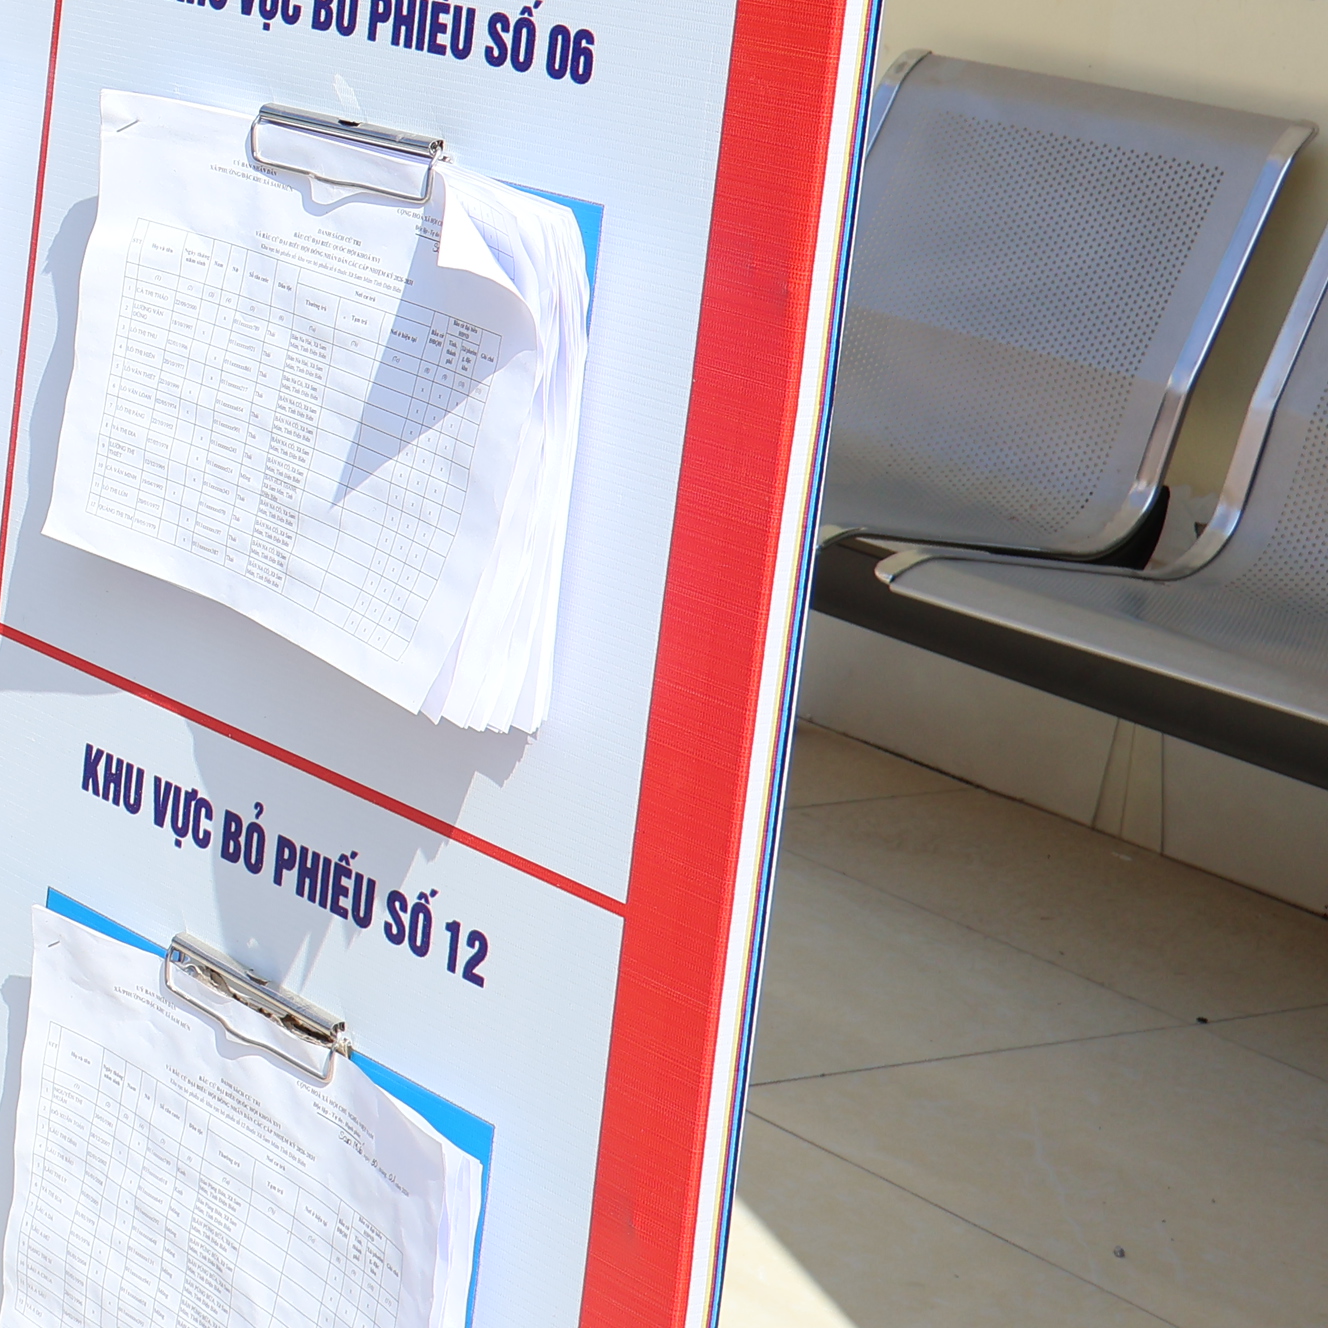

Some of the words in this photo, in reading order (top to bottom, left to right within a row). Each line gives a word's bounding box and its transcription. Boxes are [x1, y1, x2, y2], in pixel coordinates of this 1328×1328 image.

[484, 0, 542, 73] SỐ
[546, 24, 594, 85] 06
[82, 743, 144, 814] KHU
[154, 775, 213, 849] VỰC
[220, 802, 266, 874] BỎ
[273, 834, 376, 929] PHIẾU
[384, 889, 438, 957] SỐ
[445, 920, 488, 988] 12
